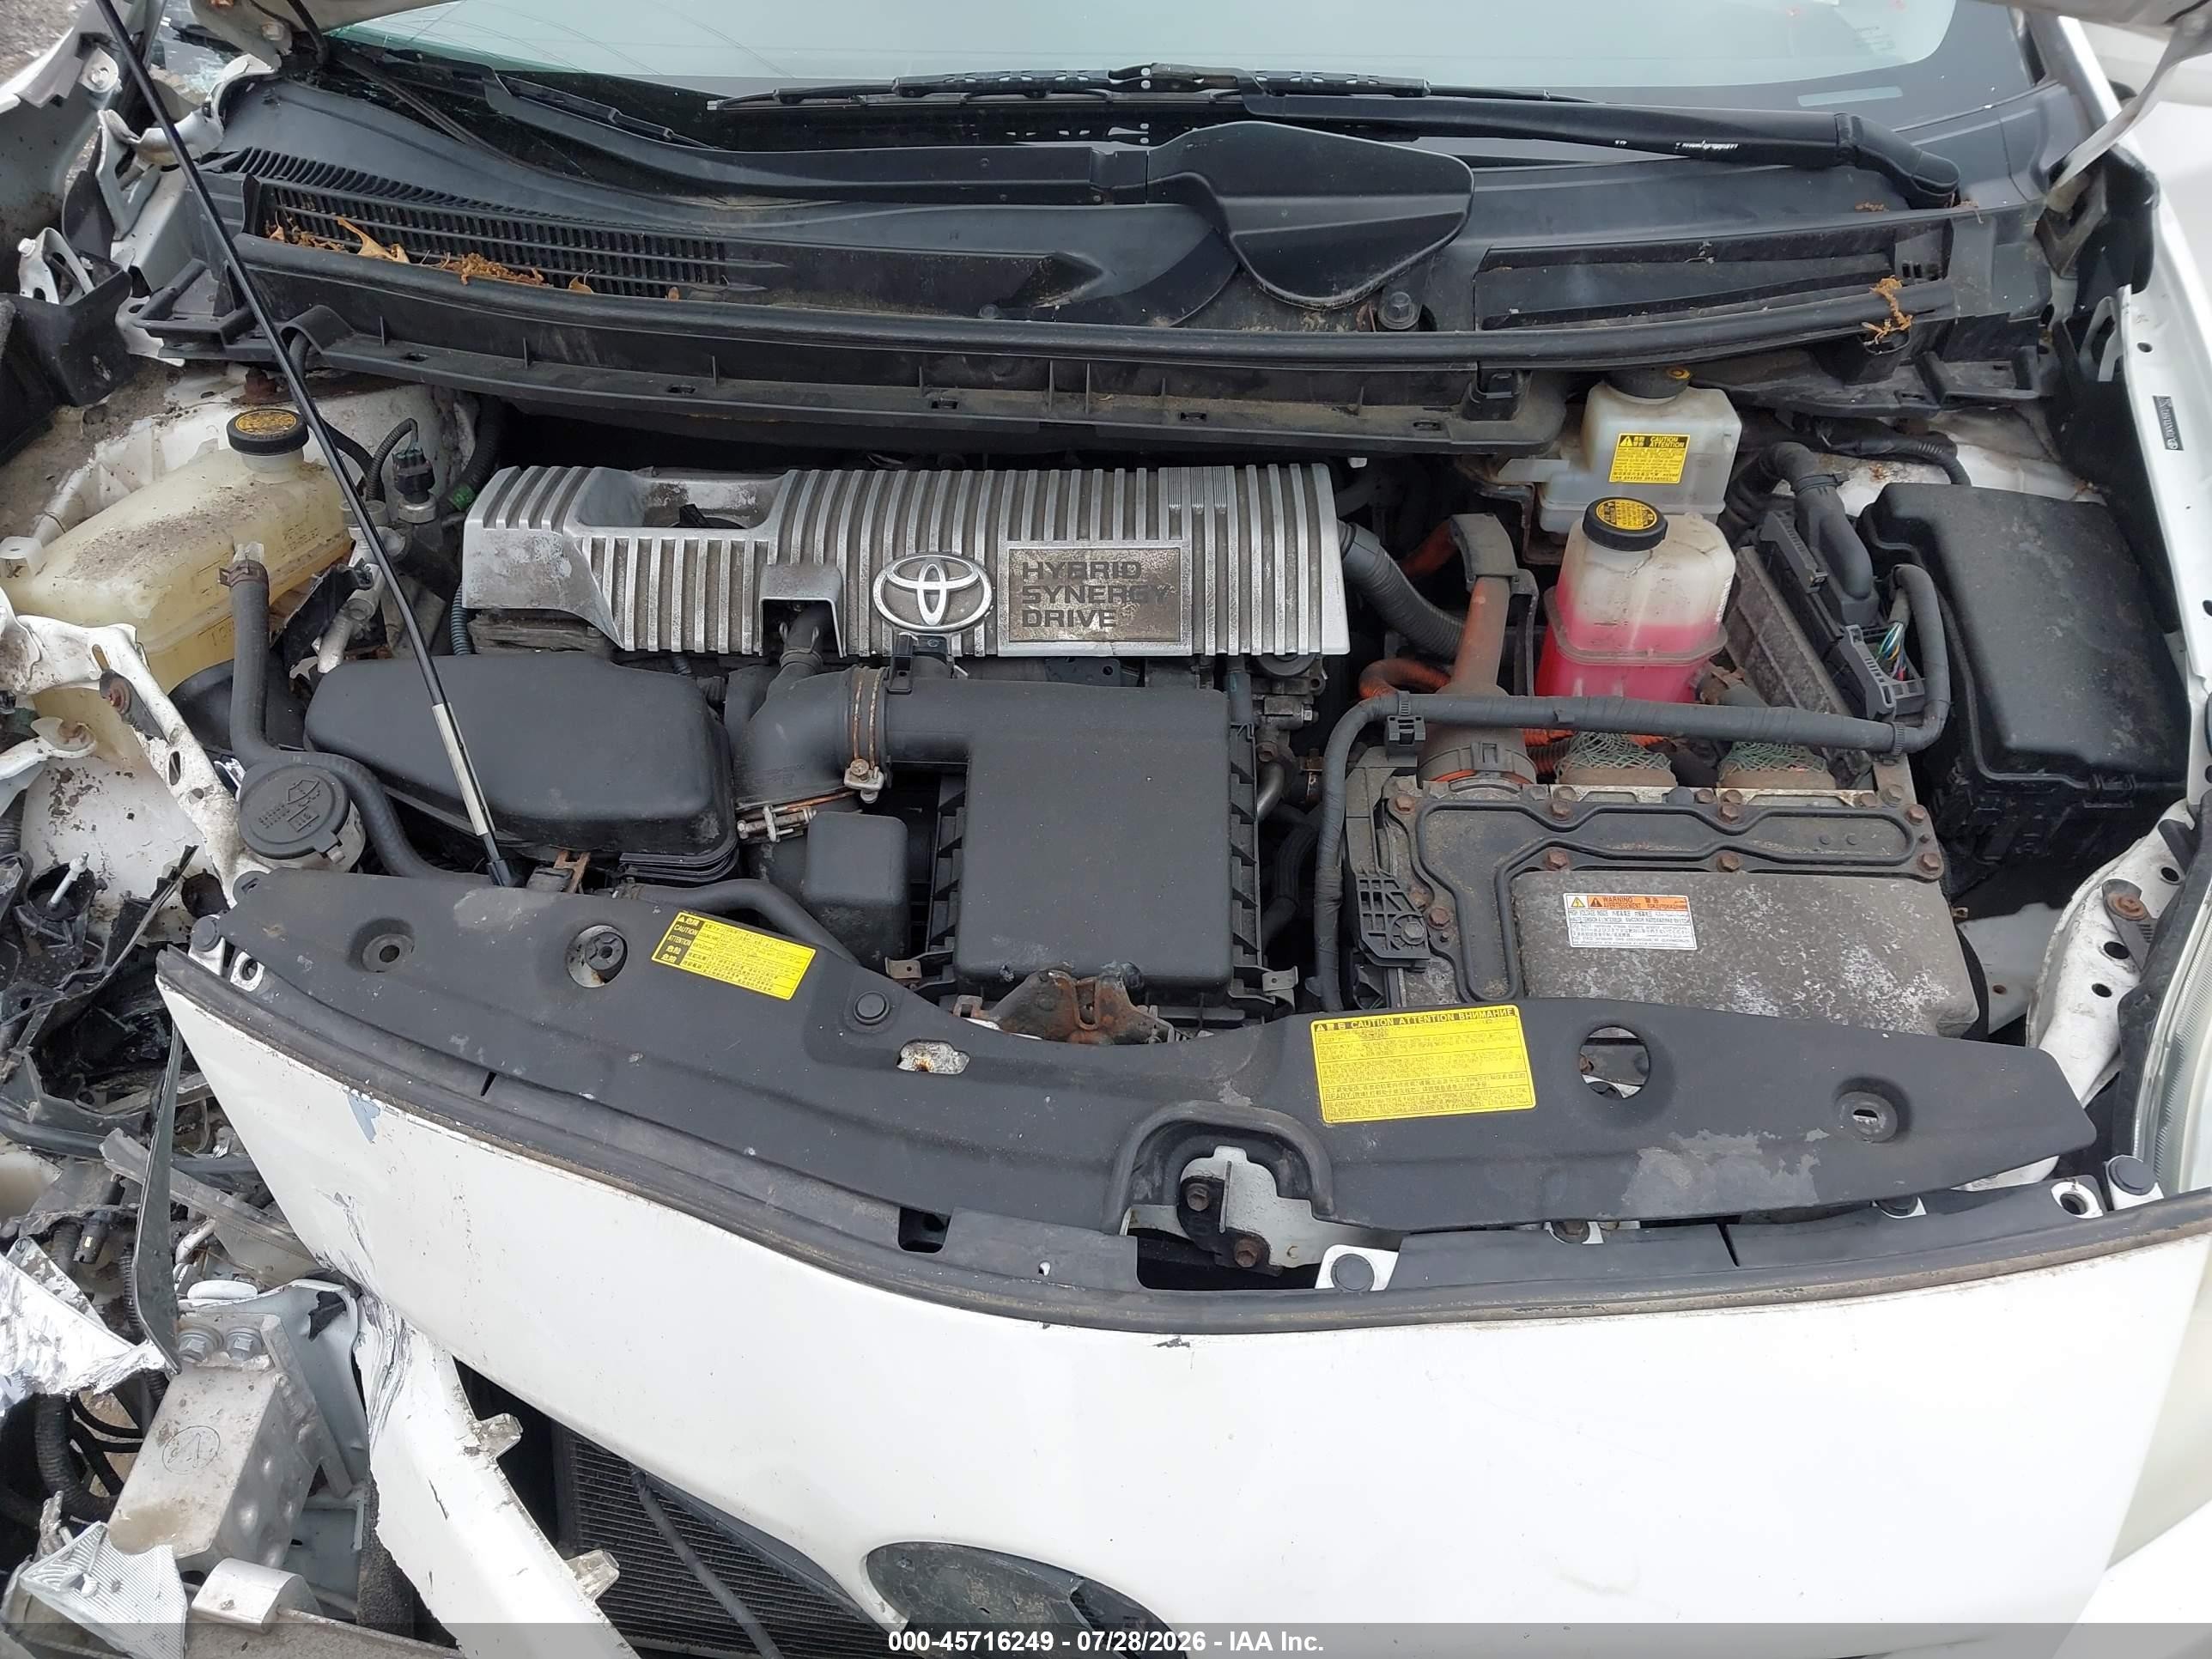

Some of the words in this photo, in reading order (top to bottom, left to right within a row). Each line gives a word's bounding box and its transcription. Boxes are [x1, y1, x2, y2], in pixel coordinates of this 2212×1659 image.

[1022, 561, 1142, 580] HYBRID
[1022, 585, 1169, 604] SYNERGY
[1022, 609, 1116, 628] DRIVE
[674, 924, 699, 936] CAUTION
[667, 934, 692, 946] ATTENTION
[1351, 1017, 1394, 1029] CAUTION
[1399, 1013, 1455, 1025] ATTENTION
[1460, 1007, 1515, 1020] ВНИМАНИЕ
